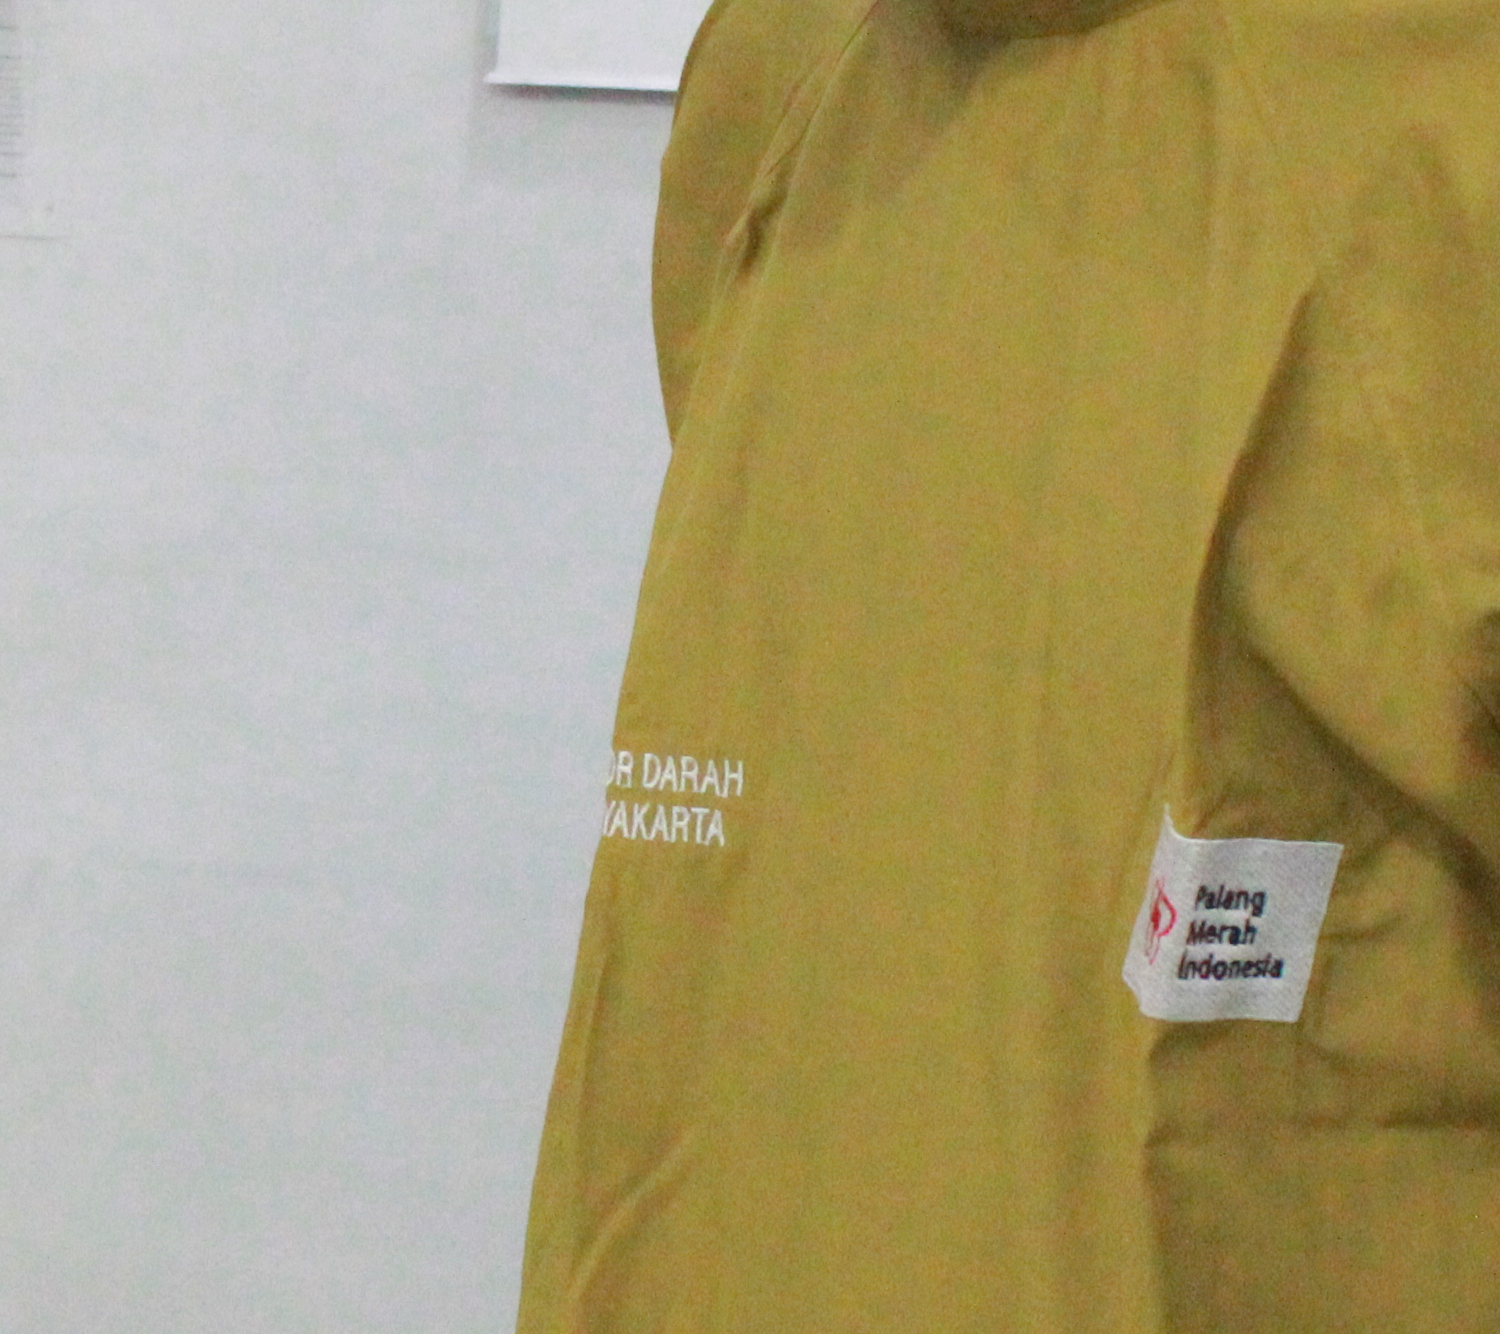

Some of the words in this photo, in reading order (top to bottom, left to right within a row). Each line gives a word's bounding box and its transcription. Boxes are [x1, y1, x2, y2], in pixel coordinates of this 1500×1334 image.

[642, 753, 744, 798] DARAH
[1195, 884, 1267, 917] Palang
[1186, 919, 1257, 946] Merah
[1177, 949, 1284, 981] Indonesia
